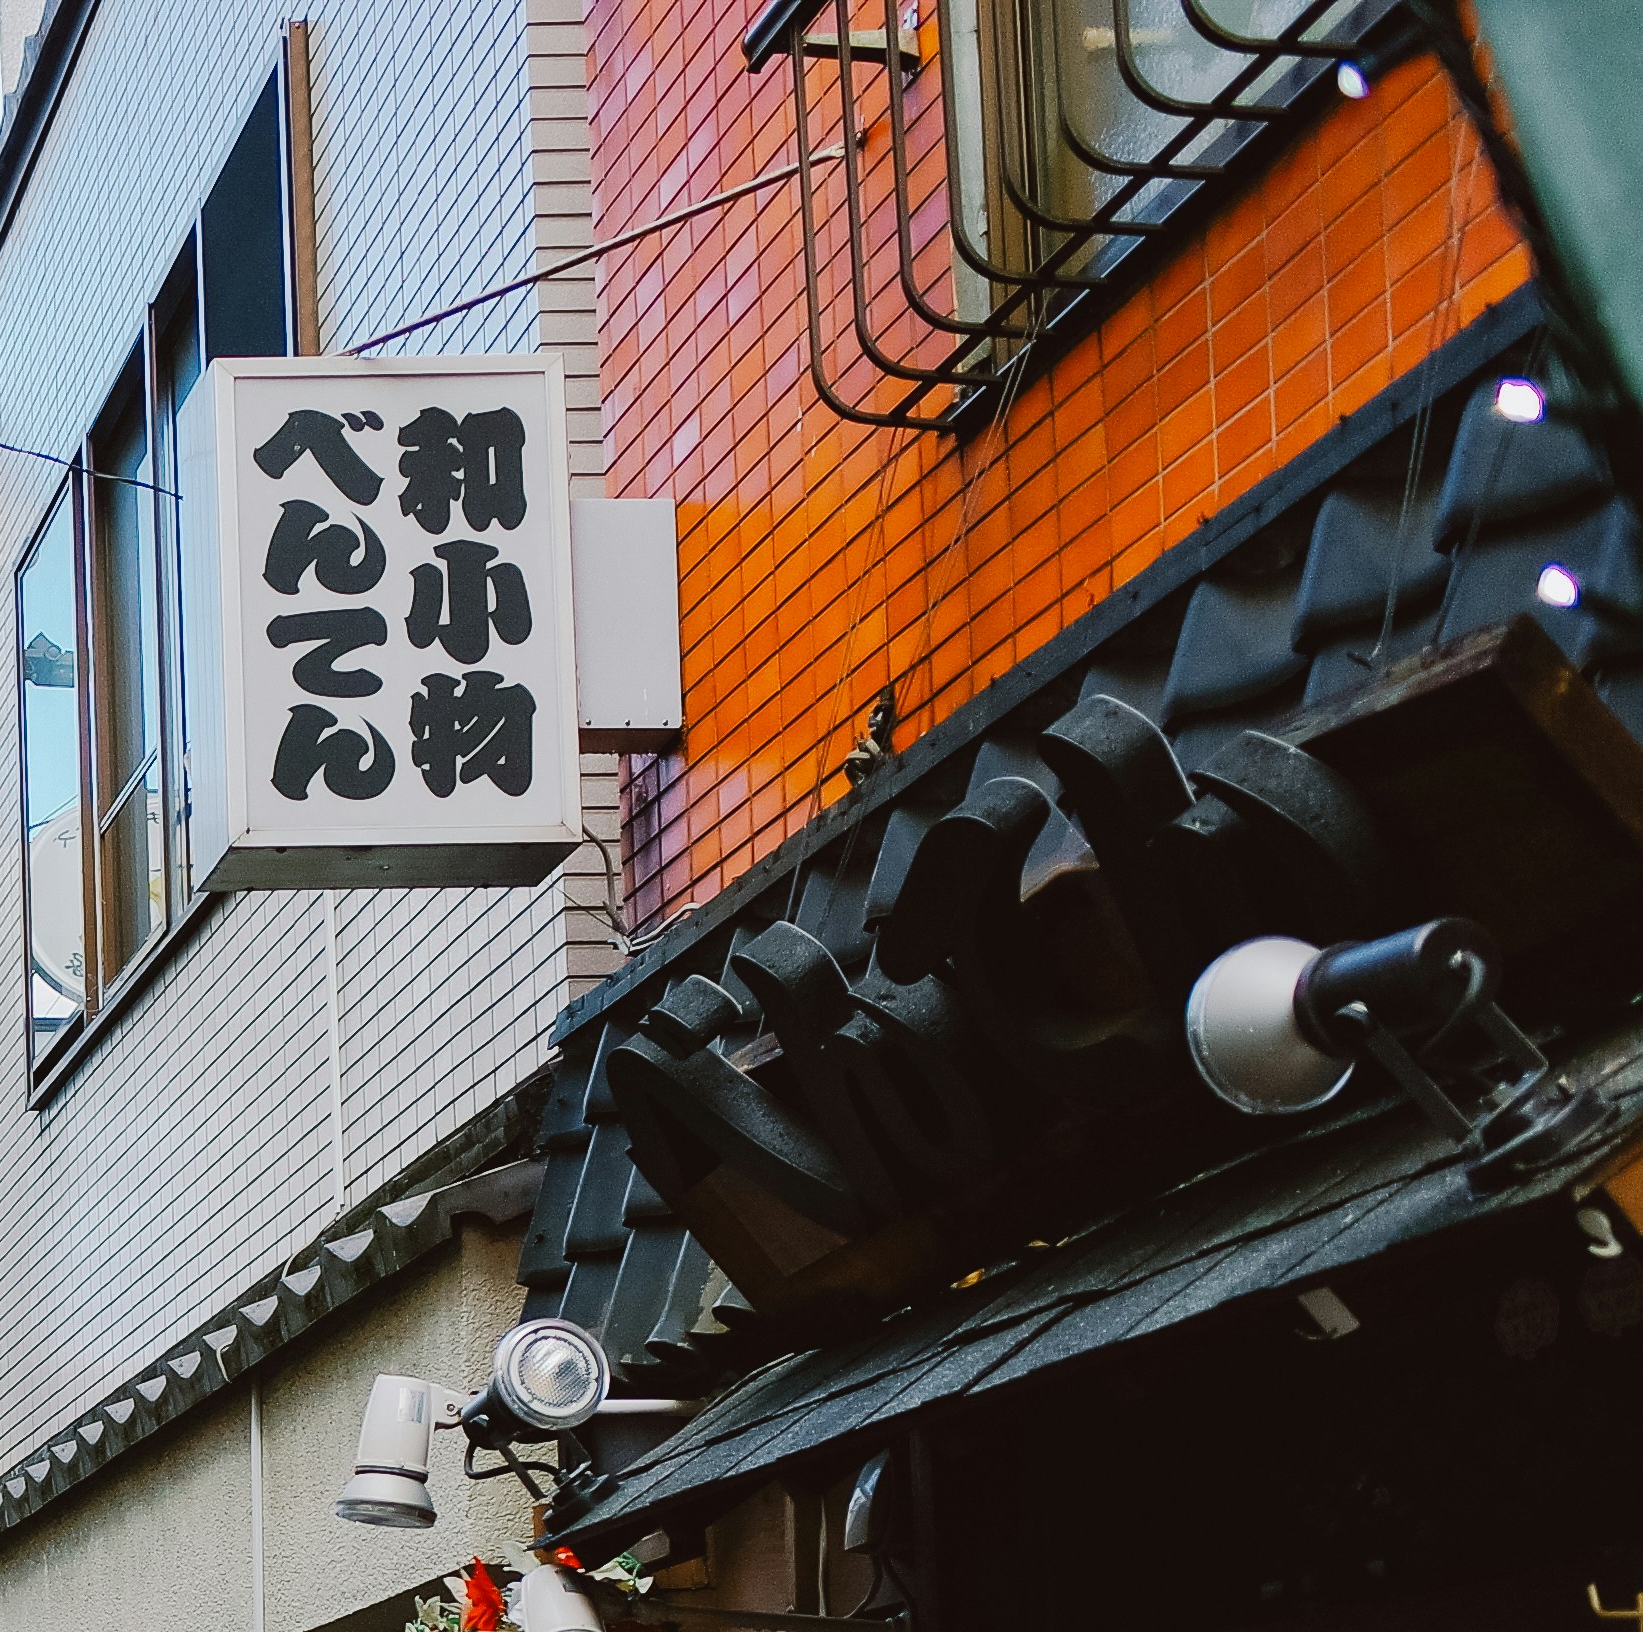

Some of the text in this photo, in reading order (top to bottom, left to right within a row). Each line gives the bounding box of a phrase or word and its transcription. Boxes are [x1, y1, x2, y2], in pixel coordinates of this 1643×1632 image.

[253, 409, 396, 801] べんてん
[397, 406, 536, 798] 和小物
